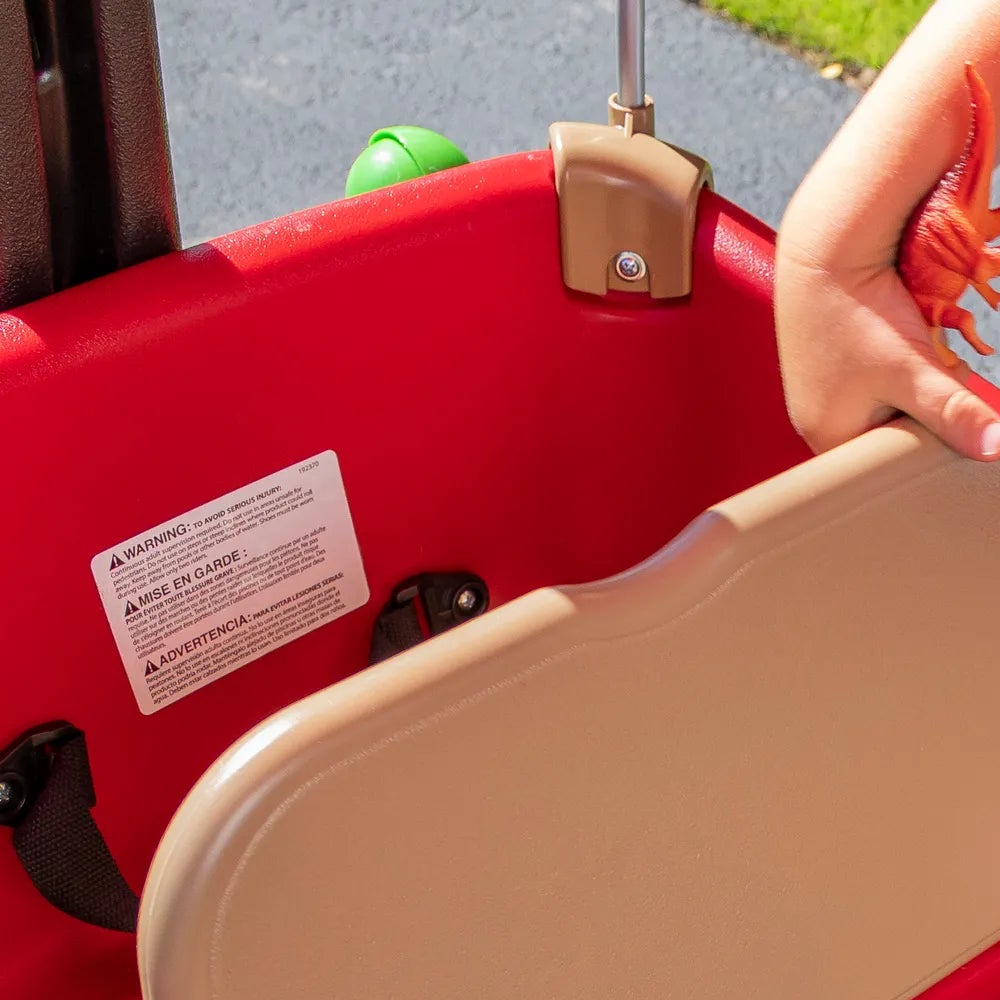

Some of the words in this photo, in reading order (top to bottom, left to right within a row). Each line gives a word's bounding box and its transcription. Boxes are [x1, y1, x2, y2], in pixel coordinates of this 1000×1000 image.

[298, 460, 319, 473] 192370
[123, 523, 191, 560] WARNING:
[192, 520, 203, 528] TO
[204, 510, 225, 524] AVOID
[226, 496, 255, 514] SERIOUS
[255, 485, 281, 500] INJURY:
[125, 612, 143, 625] POUR
[163, 591, 184, 605] TOUTE
[184, 577, 214, 596] BLESSURE
[214, 567, 234, 581] GRAVE
[138, 583, 171, 607] MISE
[173, 573, 191, 590] EN
[194, 549, 241, 579] GARDE
[160, 614, 252, 667] ADVERTENCIA:
[252, 608, 270, 620] PARA
[270, 596, 292, 612] EVITAR
[291, 582, 321, 601] LESIONES
